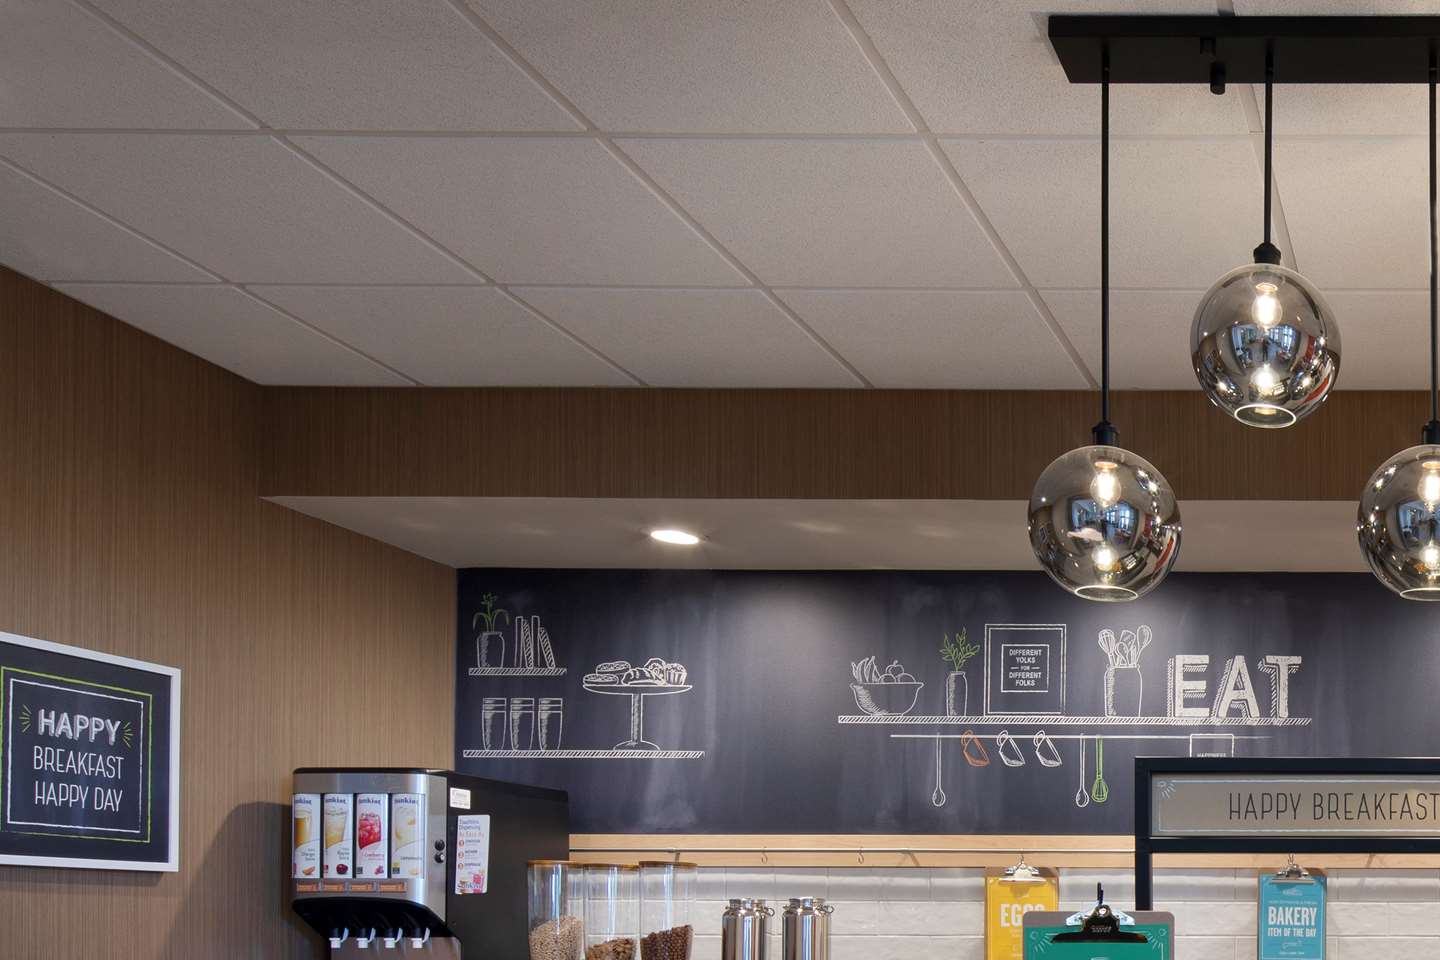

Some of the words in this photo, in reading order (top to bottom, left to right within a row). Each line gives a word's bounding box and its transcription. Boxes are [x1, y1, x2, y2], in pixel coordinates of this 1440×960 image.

[1167, 654, 1302, 718] EAT
[38, 708, 121, 746] HAPPY
[33, 745, 124, 780] BREAKFAST
[34, 780, 89, 809] HAPPY
[94, 787, 123, 812] DAY
[1229, 792, 1302, 821] HAPPY
[1313, 792, 1440, 821] BREAKFAST
[1268, 906, 1317, 926] BAKERY
[1268, 928, 1282, 936] ITEM
[1284, 928, 1290, 936] OF
[1293, 928, 1304, 936] THE
[1306, 928, 1316, 937] DAY
